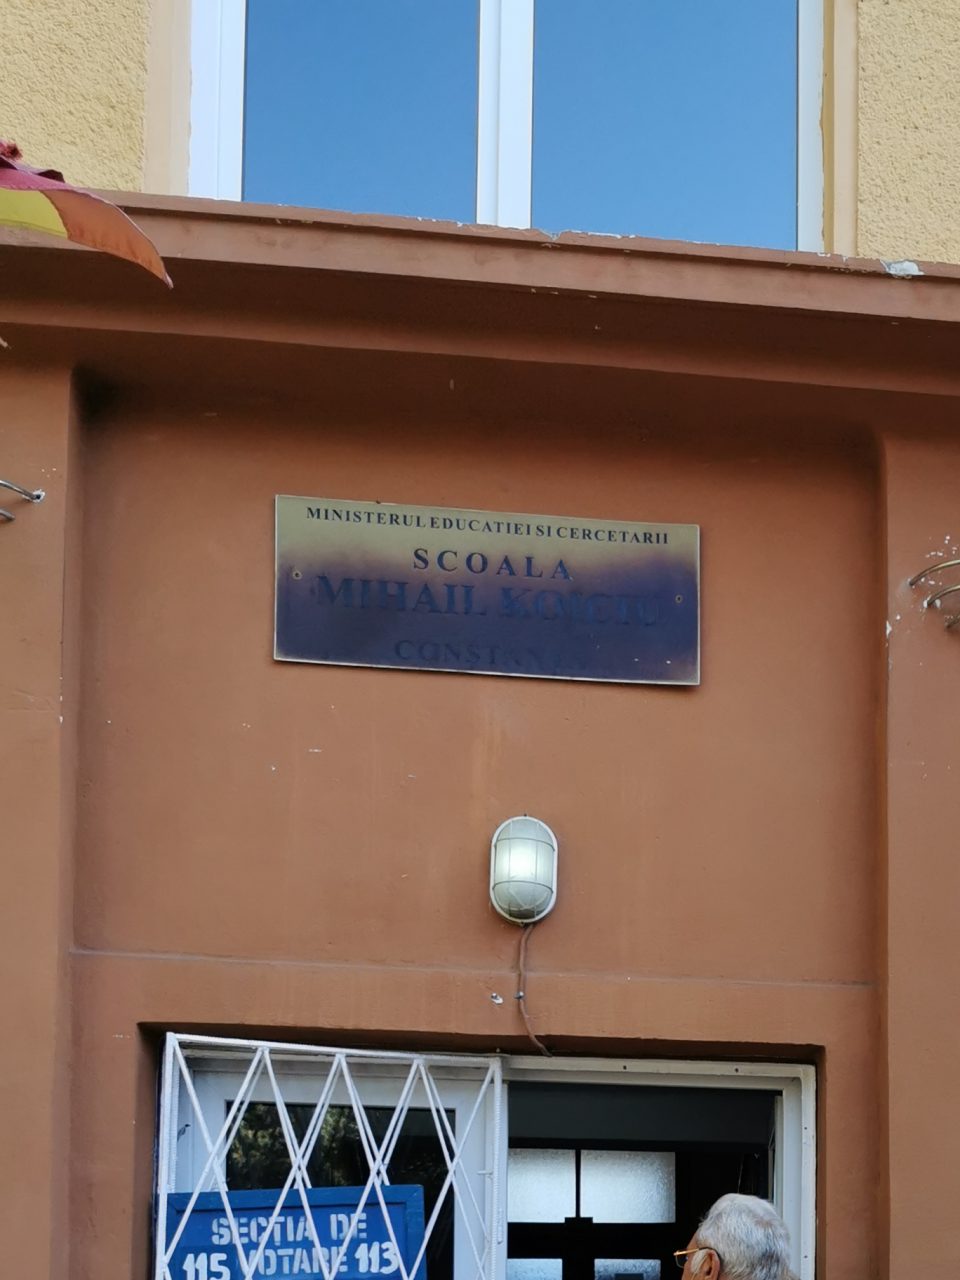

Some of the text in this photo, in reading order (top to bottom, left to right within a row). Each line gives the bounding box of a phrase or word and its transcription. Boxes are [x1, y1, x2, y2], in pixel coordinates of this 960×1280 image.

[306, 506, 670, 547] MINISTERUL EDUCATIEI SI CERCETARII
[412, 547, 574, 581] SCOALA
[314, 574, 489, 617] MIHAIL
[393, 638, 590, 674] CONSTAN
[329, 1212, 367, 1241] DE
[354, 1241, 401, 1275] 113
